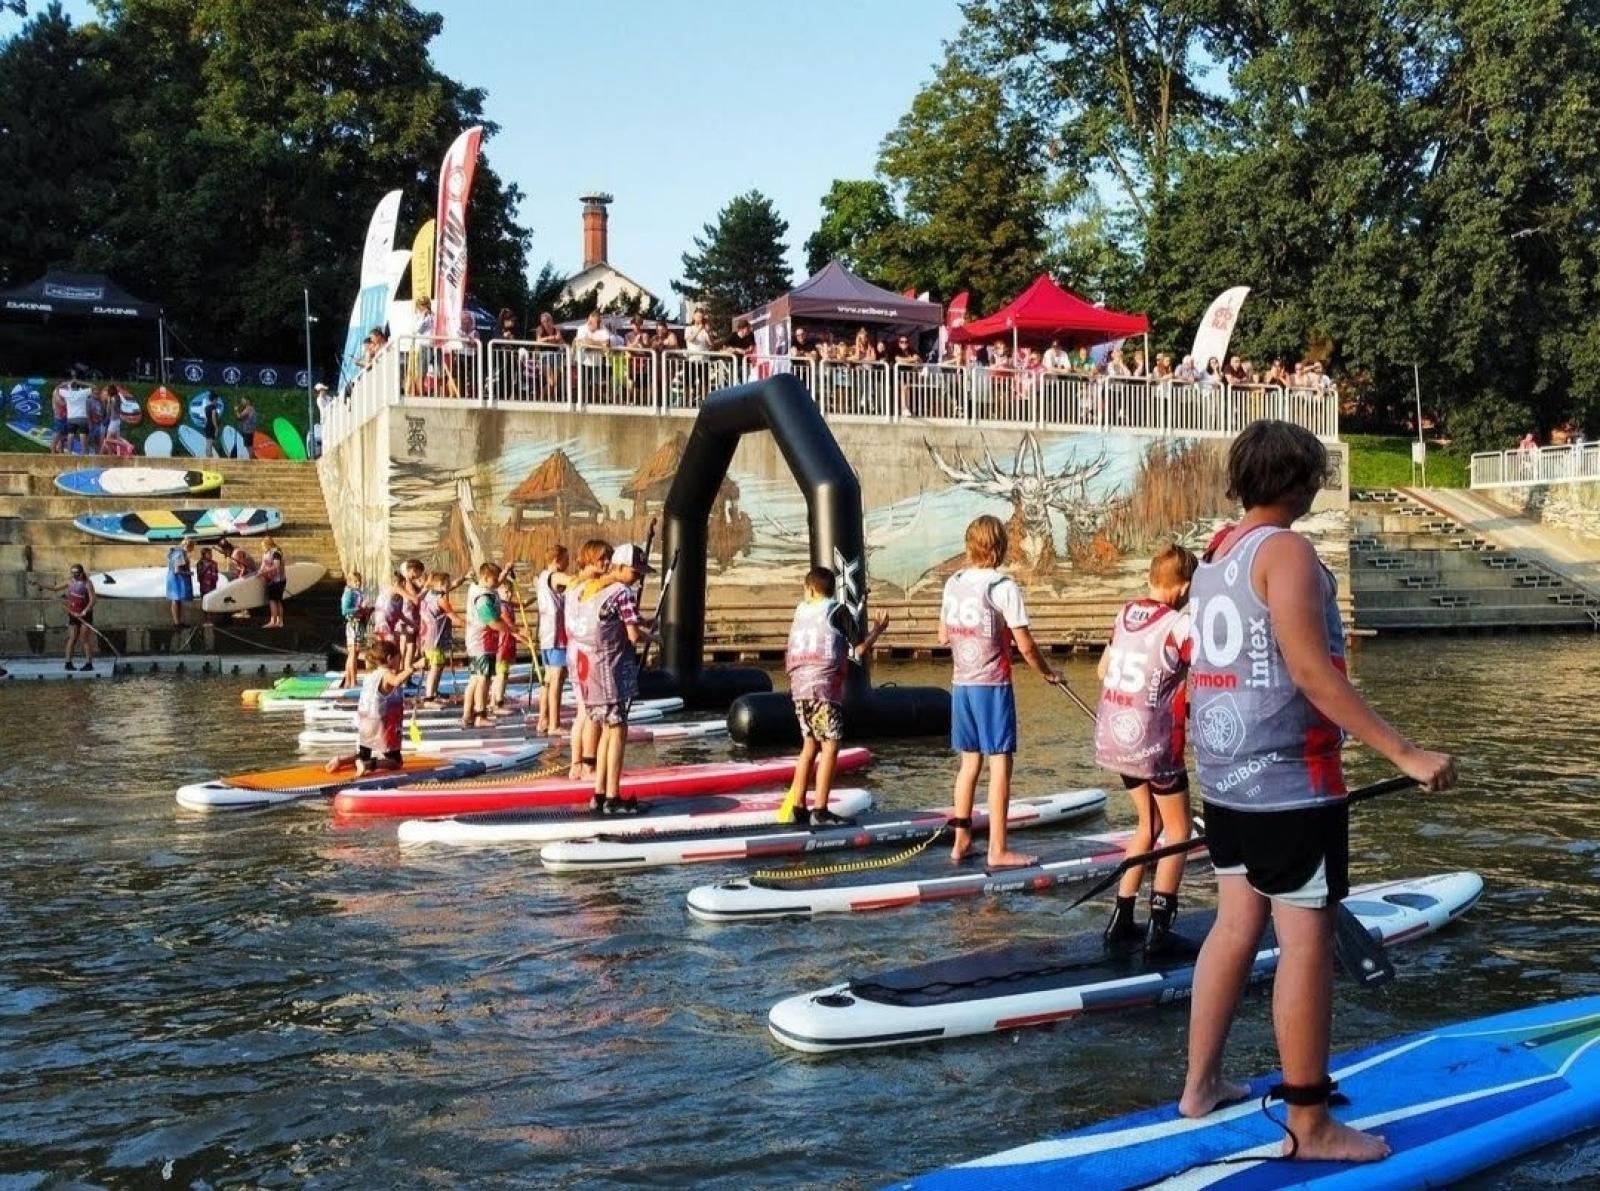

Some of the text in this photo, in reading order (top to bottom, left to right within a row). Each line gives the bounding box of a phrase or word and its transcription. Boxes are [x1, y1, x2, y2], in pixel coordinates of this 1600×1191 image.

[6, 301, 53, 312] DAKINE
[92, 306, 139, 316] DAKINE
[836, 305, 899, 318] www.raciborz.pl
[1245, 615, 1270, 689] intex
[1104, 646, 1147, 693] 35
[1103, 687, 1134, 707] Alex
[1145, 666, 1163, 708] intex
[1215, 751, 1283, 793] RACIBÓRZ
